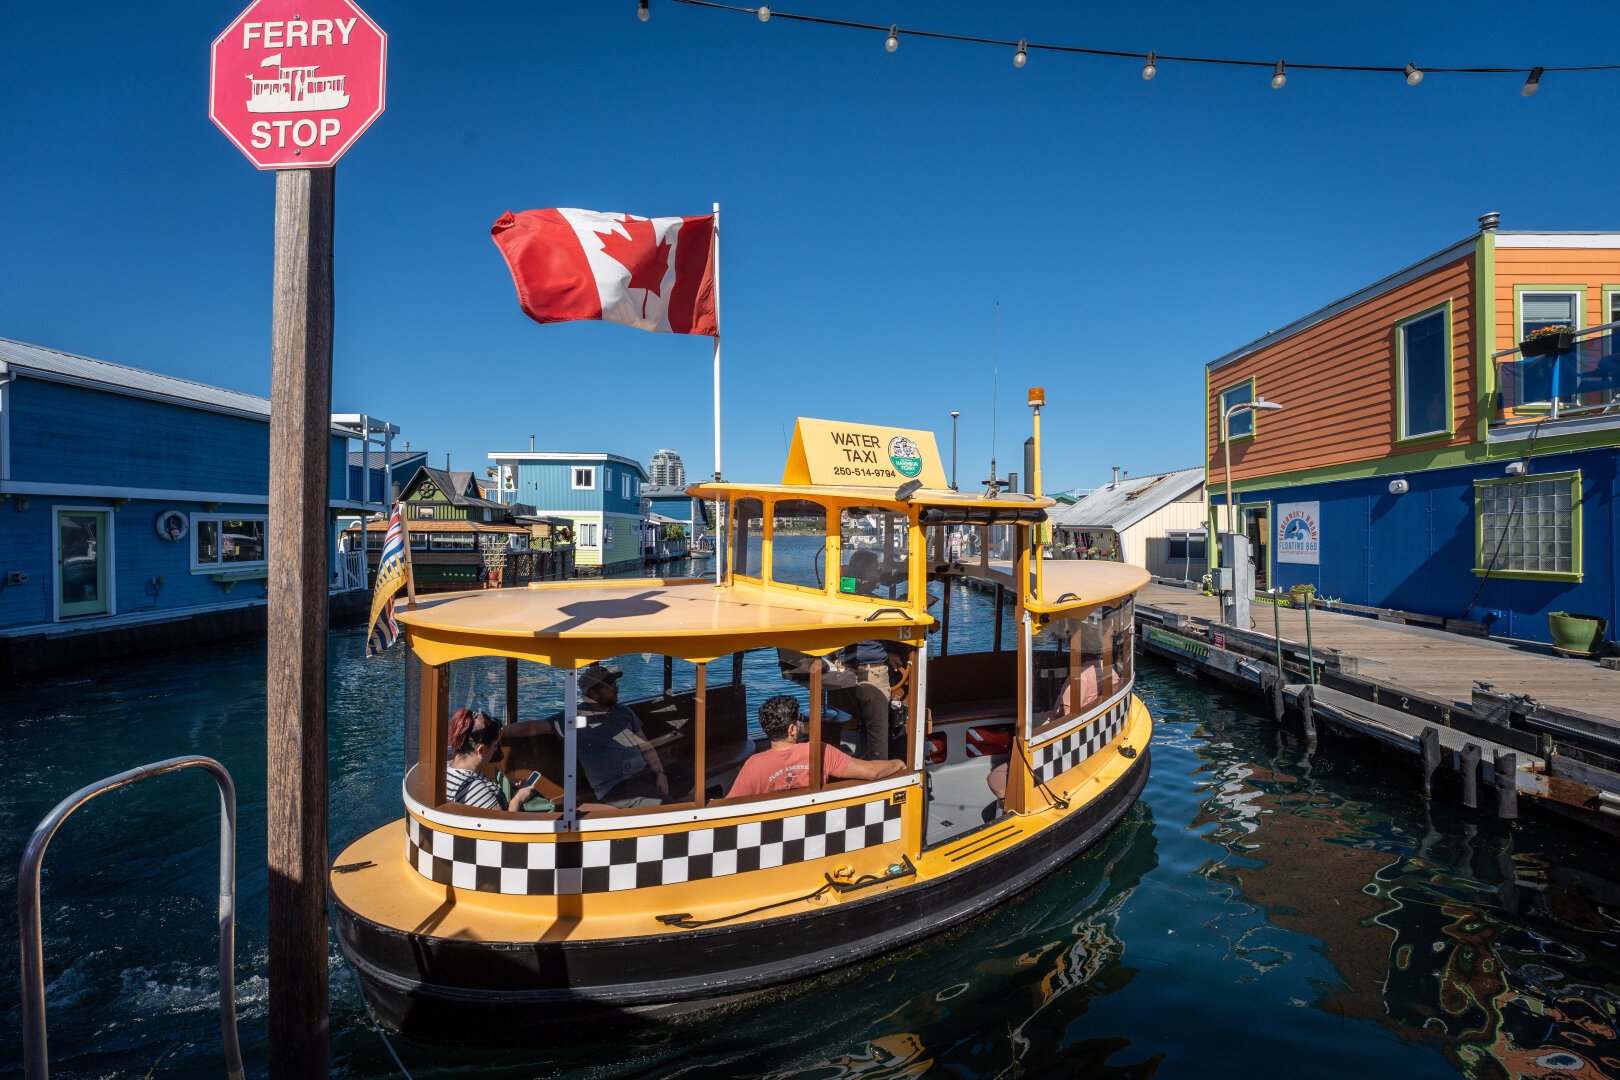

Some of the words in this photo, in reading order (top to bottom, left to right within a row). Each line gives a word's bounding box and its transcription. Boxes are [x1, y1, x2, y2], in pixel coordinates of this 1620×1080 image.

[243, 17, 358, 50] FERRY
[250, 118, 342, 149] STOP
[830, 431, 881, 449] WATER
[842, 448, 878, 464] TAXI
[833, 466, 896, 478] 250-514-9794
[1279, 541, 1304, 550] FLOATING
[1305, 542, 1318, 551] B&B
[897, 626, 912, 640] 13
[1401, 696, 1409, 709] 2
[768, 769, 784, 782] JUST
